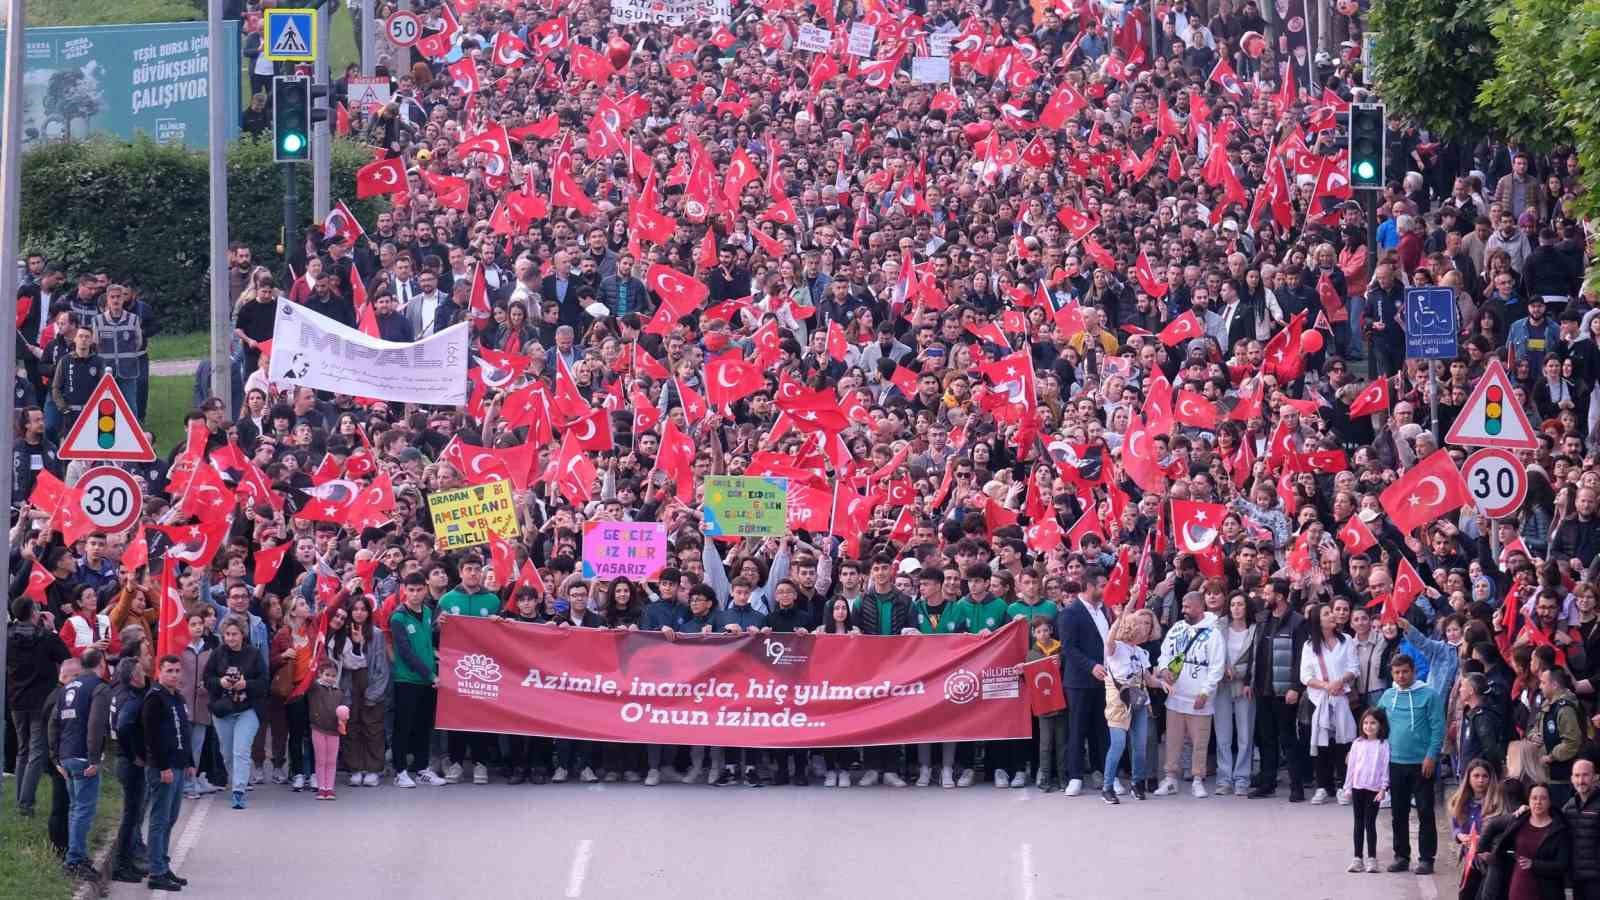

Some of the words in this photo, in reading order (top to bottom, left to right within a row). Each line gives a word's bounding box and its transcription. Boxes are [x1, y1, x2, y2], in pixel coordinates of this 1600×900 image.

[393, 21, 415, 38] 50
[133, 44, 157, 62] YEŞİL
[160, 40, 189, 57] BURSA
[133, 53, 208, 85] BÜYÜKŞEHİR
[132, 78, 207, 114] ÇALIŞIYOR
[299, 319, 443, 368] MPAL
[1474, 467, 1514, 499] 30
[86, 485, 128, 516] 30
[786, 508, 812, 523] HP
[764, 638, 785, 665] 19
[521, 668, 622, 697] Azimle,
[629, 676, 739, 703] inançla,
[746, 678, 787, 705] hiç
[794, 680, 926, 706] yılmadan
[620, 702, 709, 726] O'nun
[716, 706, 826, 727] izinde...
